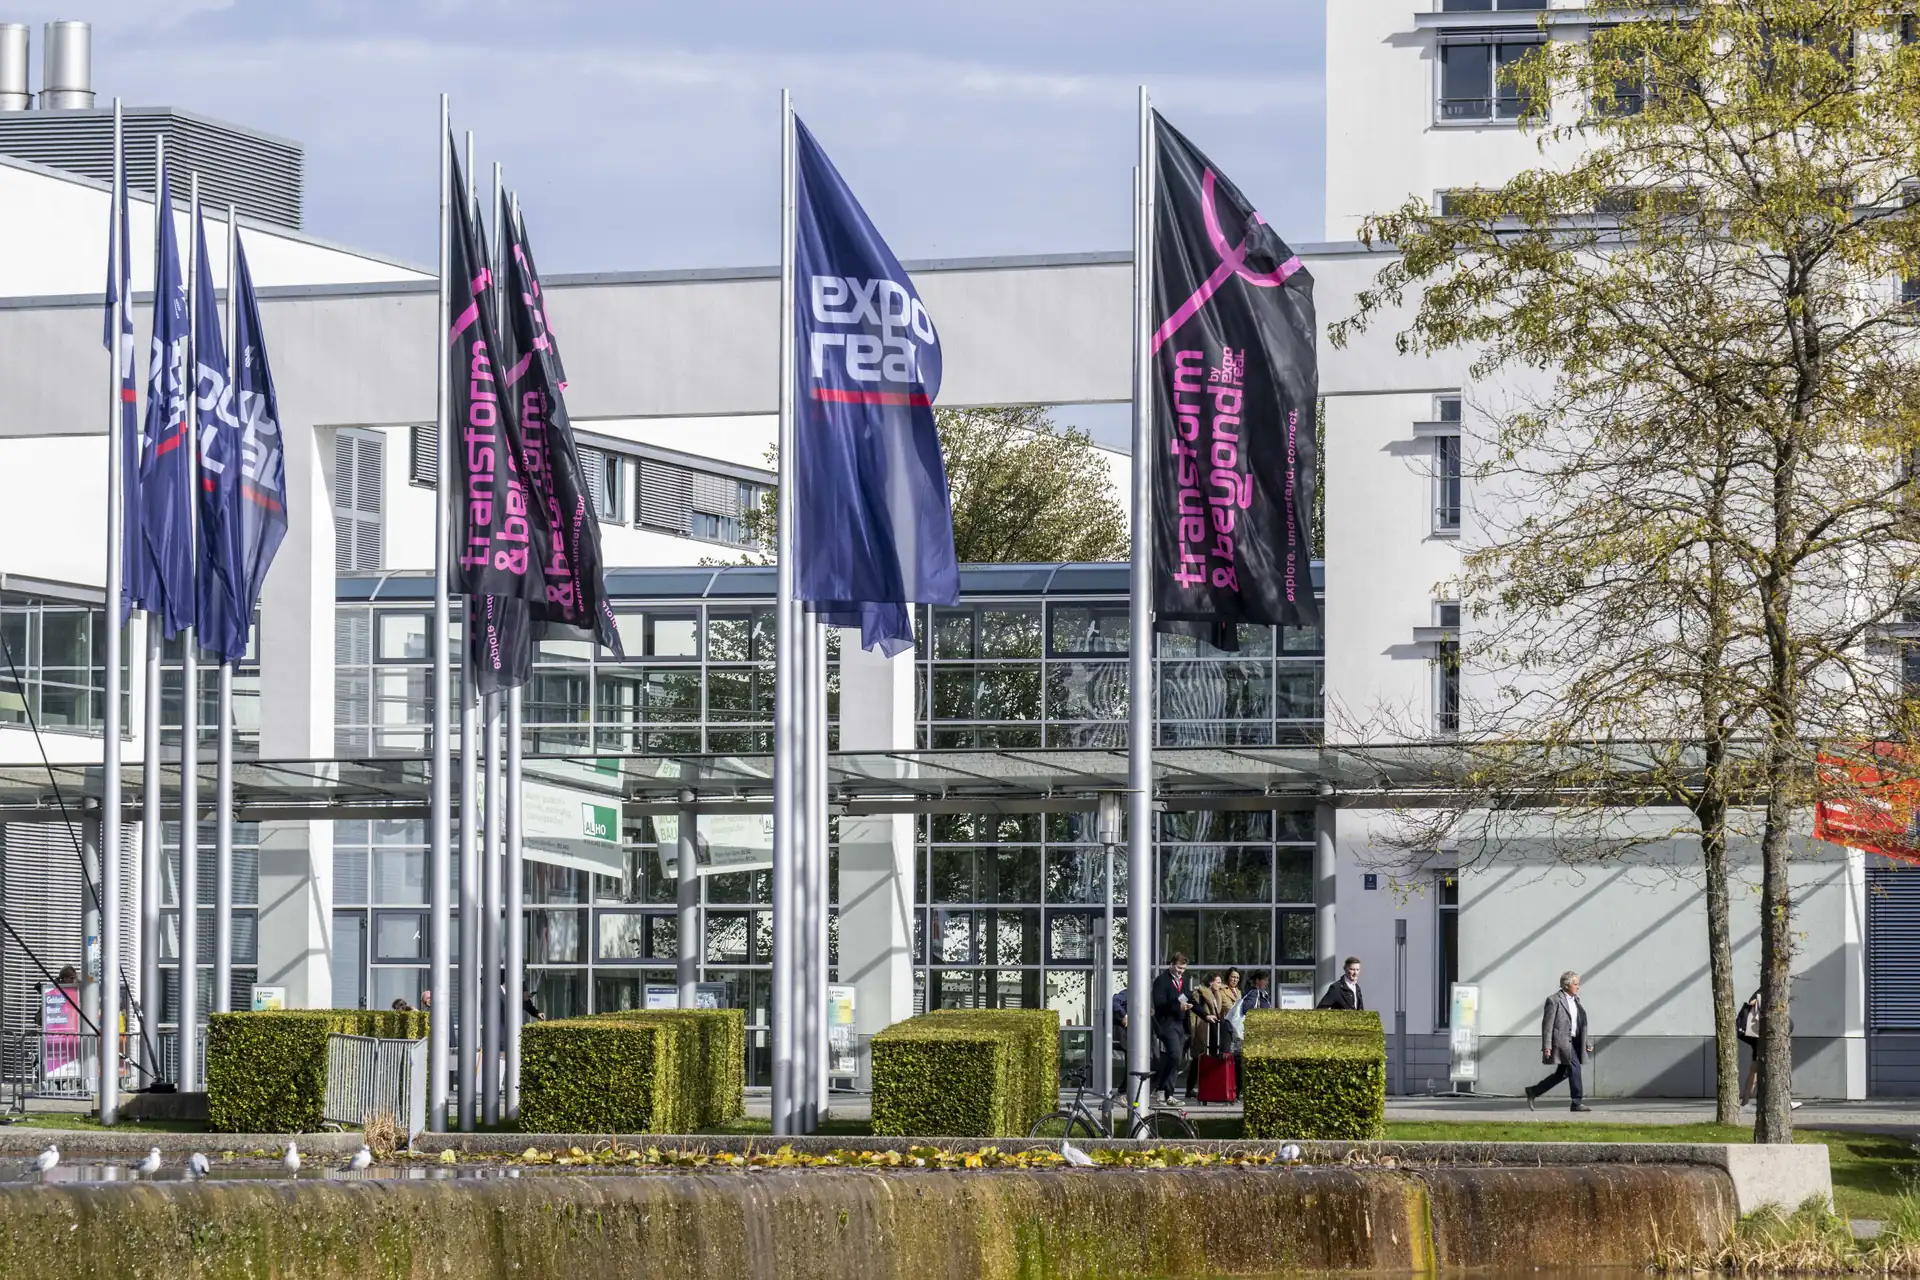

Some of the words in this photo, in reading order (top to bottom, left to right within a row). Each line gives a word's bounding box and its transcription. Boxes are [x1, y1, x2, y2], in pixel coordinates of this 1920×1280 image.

[812, 275, 935, 347] expo
[1208, 366, 1221, 382] by
[1221, 346, 1236, 383] expo
[459, 340, 497, 571] transform
[1287, 408, 1298, 465] connect.
[1171, 349, 1207, 589] transform
[1207, 386, 1253, 559] beyond
[1285, 467, 1297, 546] understand.
[1284, 549, 1296, 602] explore.
[585, 821, 606, 836] ALHO
